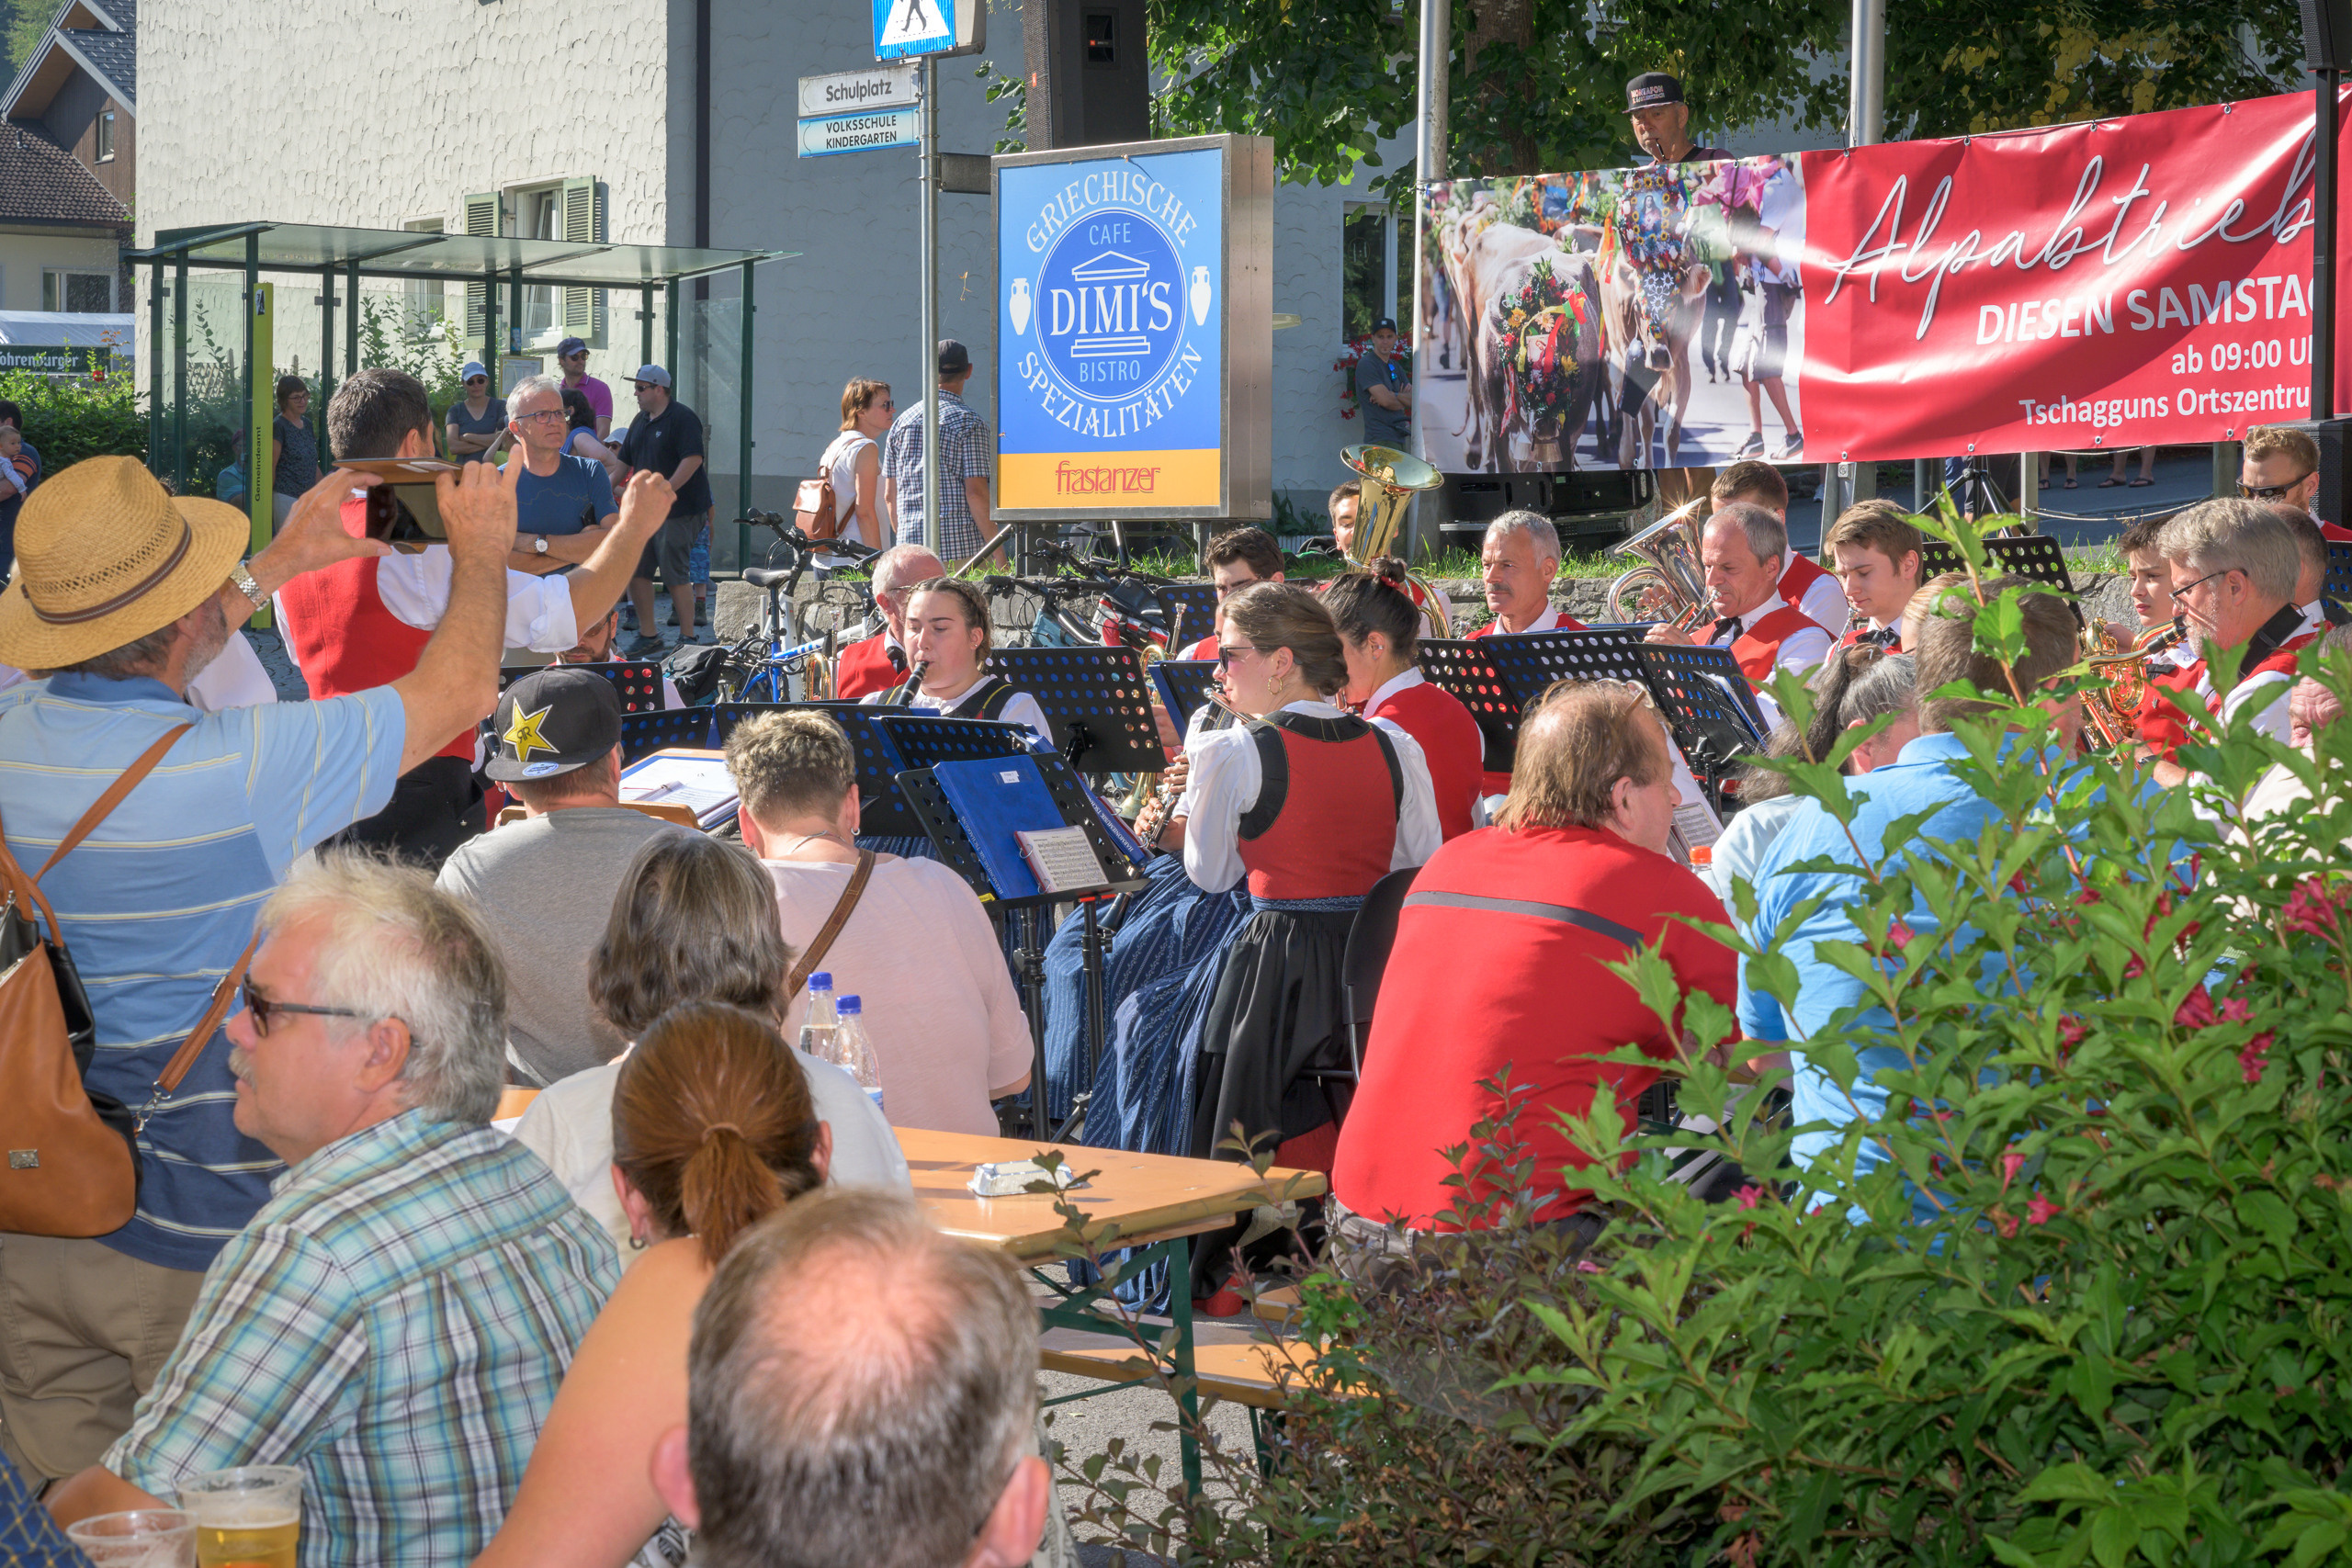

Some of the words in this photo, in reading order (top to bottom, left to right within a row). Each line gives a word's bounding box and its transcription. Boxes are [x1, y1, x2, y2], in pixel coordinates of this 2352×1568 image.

[826, 78, 892, 102] Schulplatz
[826, 115, 897, 134] VOLKSSCHULE
[826, 130, 897, 149] KINDERGARTEN
[1026, 171, 1197, 253] GRIECHISCHE
[1089, 222, 1131, 245] CAFE
[1050, 279, 1172, 336] DIMI'S
[1976, 293, 2115, 345] DIESEN
[2127, 274, 2313, 333] SAMSTA
[0, 351, 79, 370] ohrenburger
[1080, 359, 1140, 382] BISTRO
[2171, 344, 2203, 375] ab
[2211, 339, 2282, 372] 09:00
[1017, 340, 1202, 438] SPEZIALITÄTEN
[2018, 395, 2169, 428] Tschagguns
[2177, 384, 2310, 416] Ortszentru
[254, 425, 262, 502] Gemeindeamt
[1056, 460, 1161, 494] frastanzer
[960, 816, 981, 852] TSCHAGGUNS
[1100, 812, 1135, 852] HARMONIEMUSIK
[978, 850, 1004, 895] HARMONIEMUSIK
